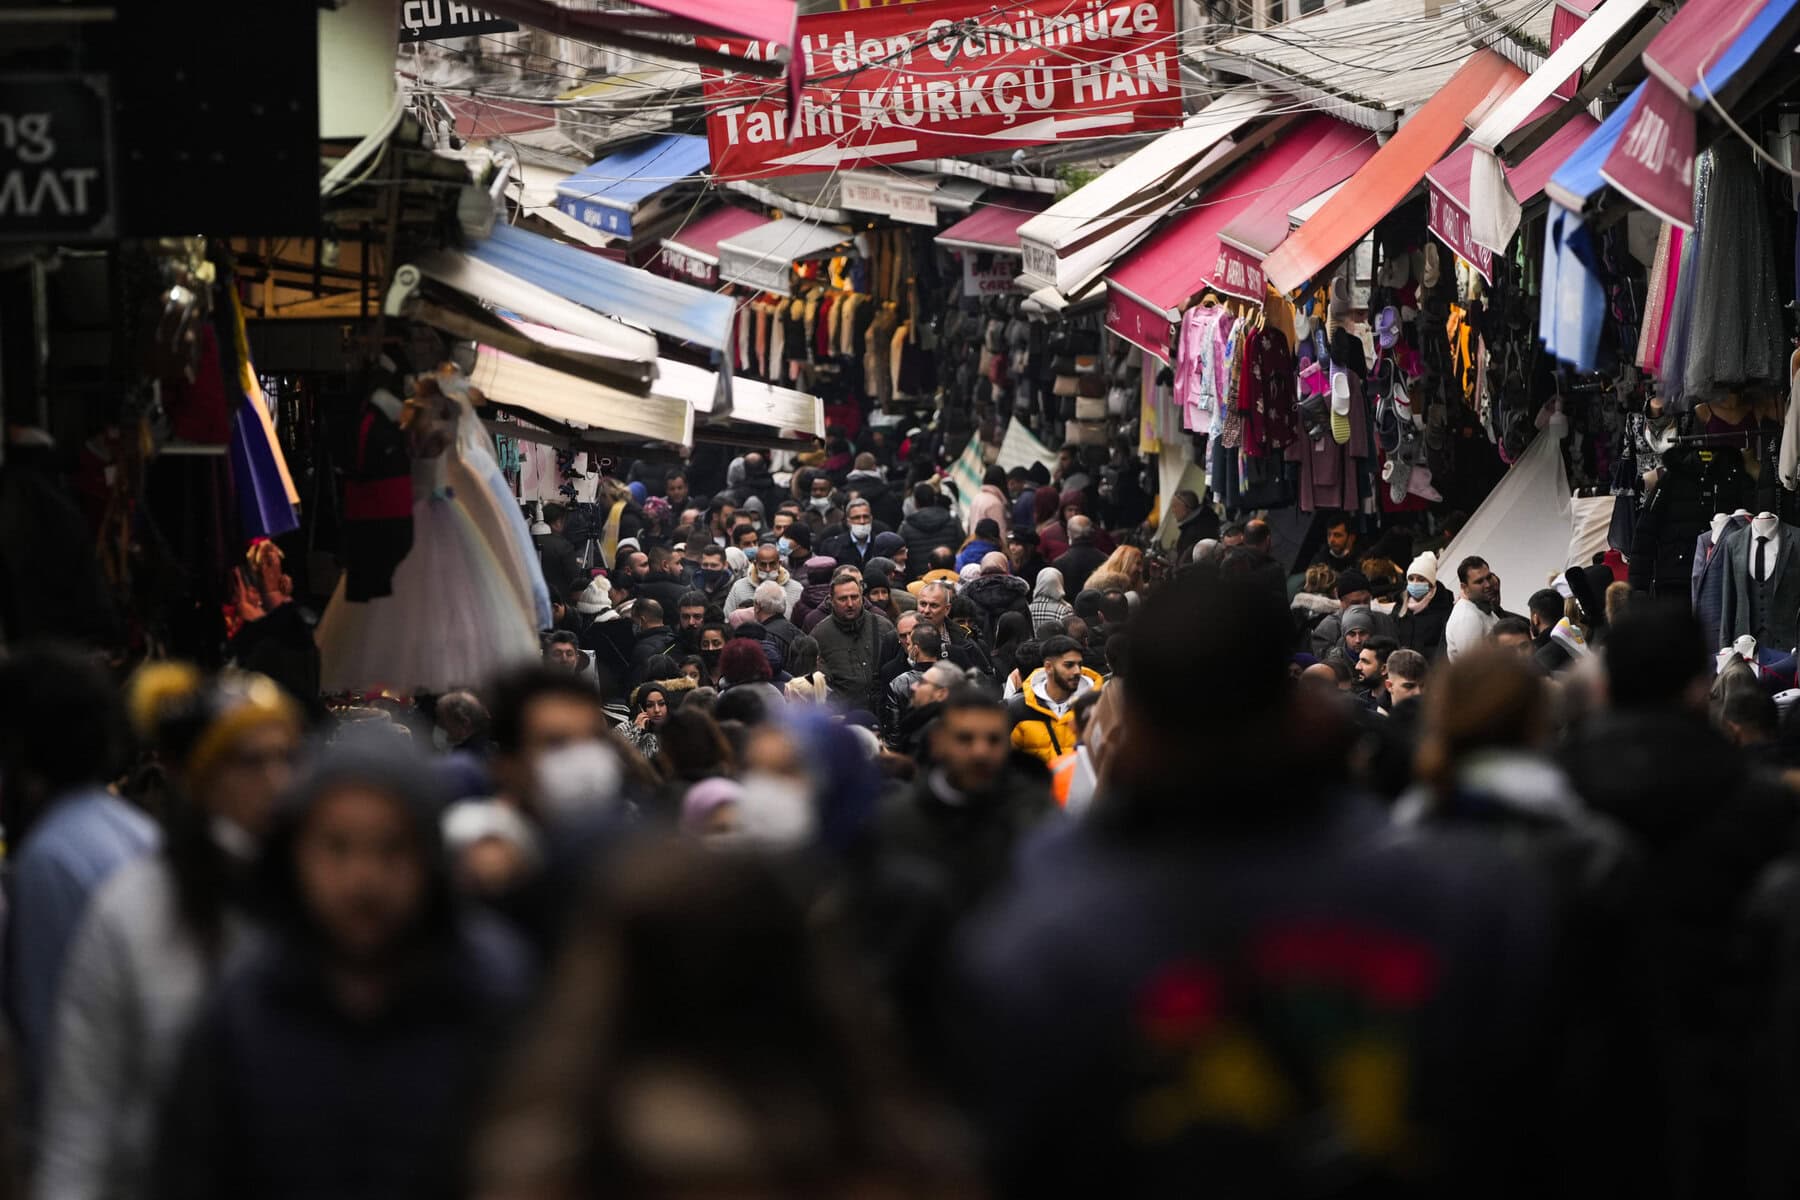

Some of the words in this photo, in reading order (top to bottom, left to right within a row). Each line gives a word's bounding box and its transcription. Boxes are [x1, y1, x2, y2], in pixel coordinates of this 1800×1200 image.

[927, 2, 1158, 61] Günümüze
[717, 93, 844, 145] Tarhi
[858, 59, 1055, 131] KÜRKÇÜ
[1071, 52, 1168, 104] HAN
